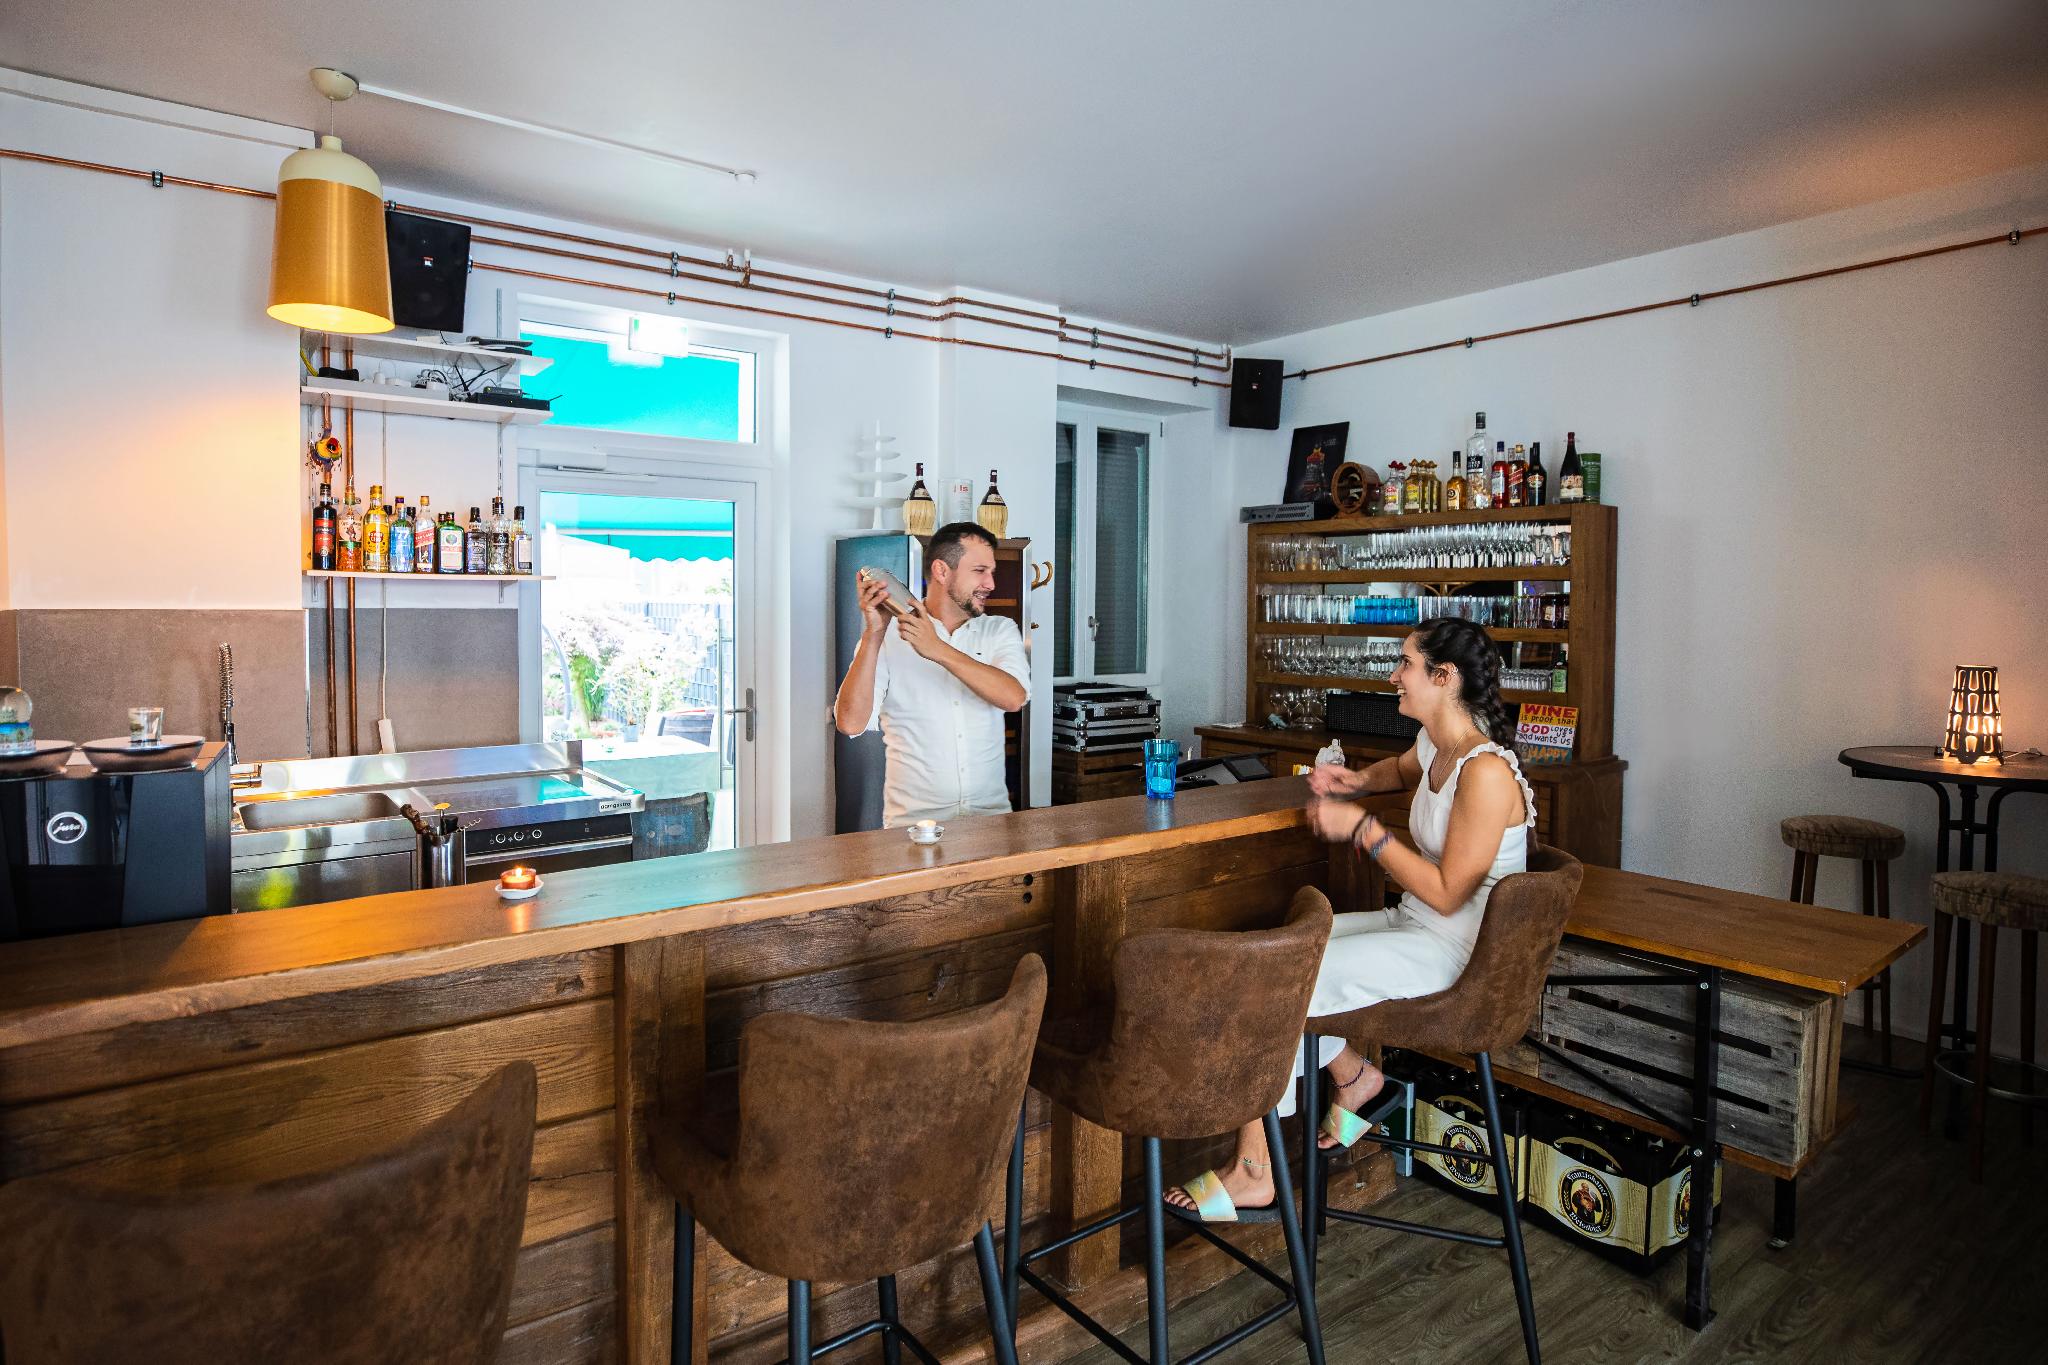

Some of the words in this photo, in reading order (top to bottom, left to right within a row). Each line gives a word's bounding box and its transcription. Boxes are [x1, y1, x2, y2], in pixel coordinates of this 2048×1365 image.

[1524, 703, 1577, 719] WINE
[1531, 715, 1553, 723] proof
[1521, 723, 1550, 734] GOD
[1535, 735, 1558, 744] wants
[52, 822, 80, 834] jura
[1566, 1171, 1608, 1197] Franziskaner
